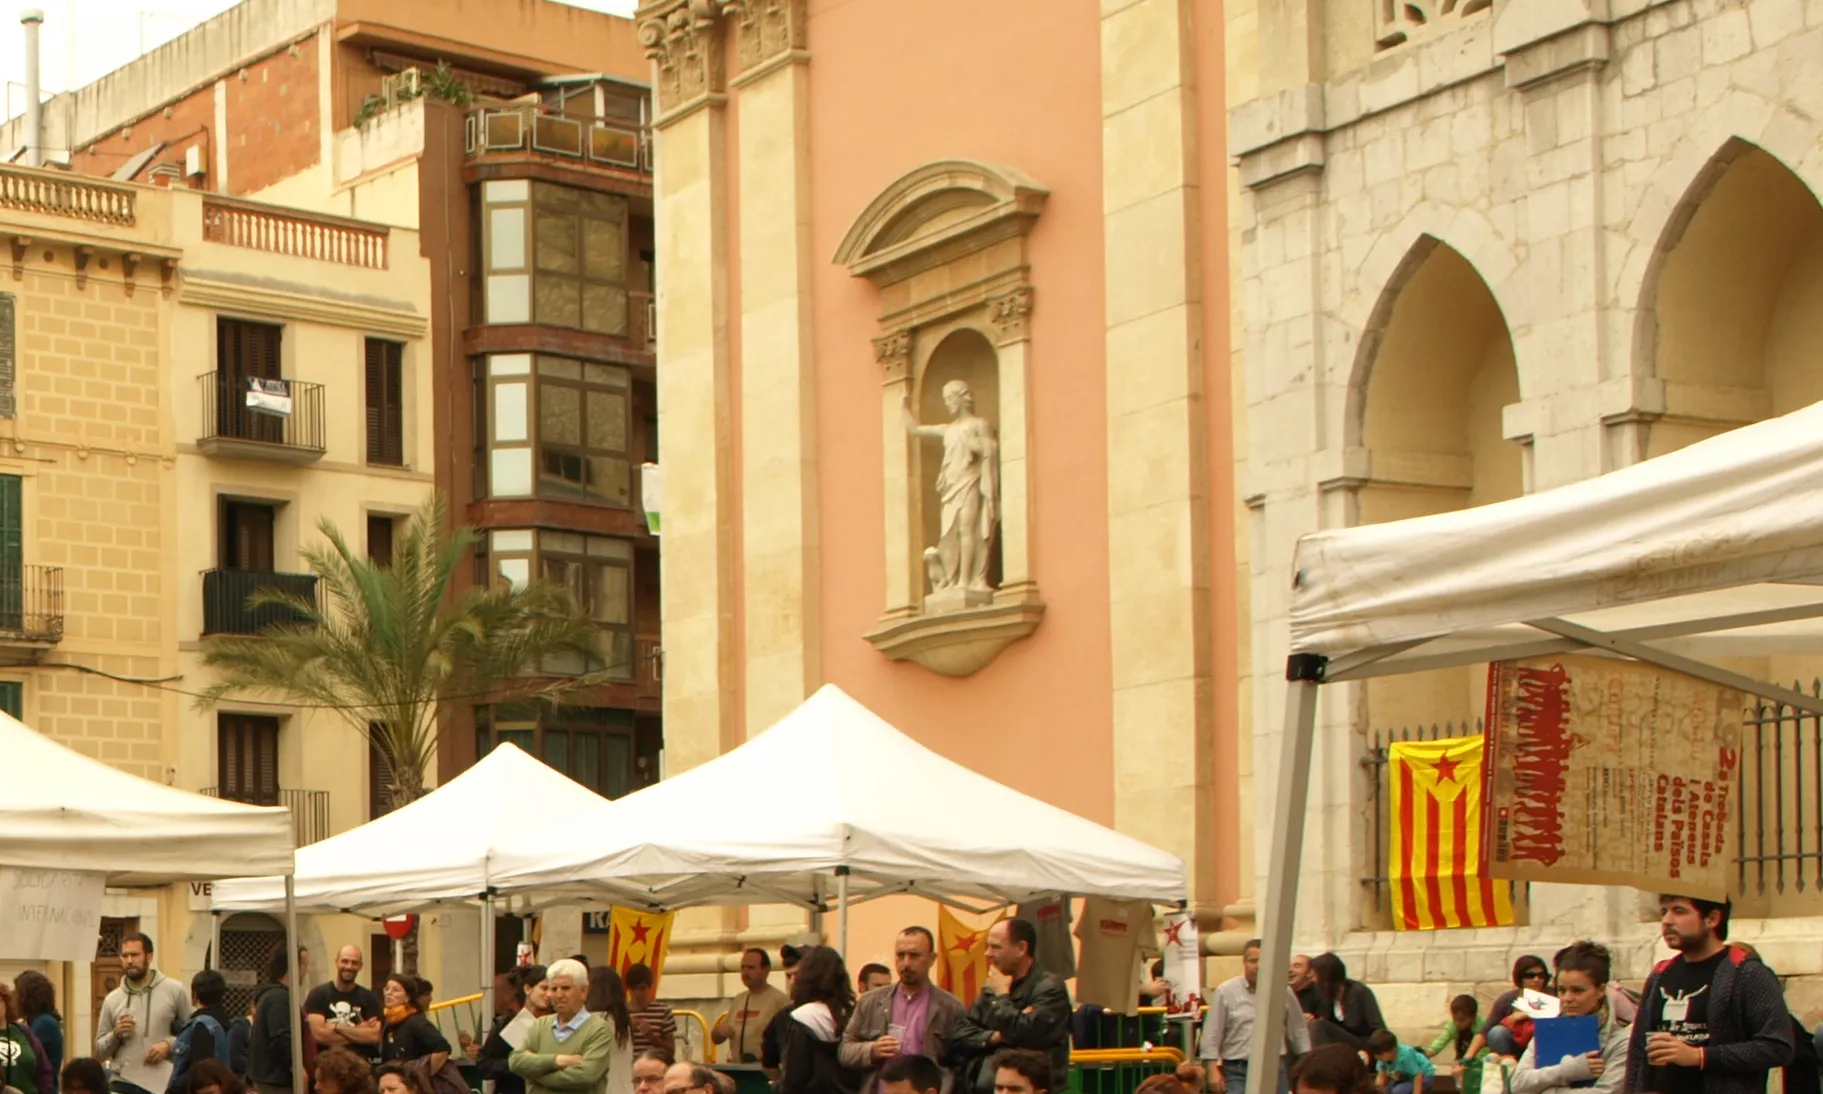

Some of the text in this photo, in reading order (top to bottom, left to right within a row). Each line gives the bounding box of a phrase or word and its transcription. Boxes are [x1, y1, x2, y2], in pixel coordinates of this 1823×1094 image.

[1653, 773, 1670, 853] Catalans
[1669, 776, 1687, 879] dels Països
[1686, 791, 1701, 866] Ateneus
[1699, 780, 1716, 868] de Casals
[1714, 786, 1730, 855] Trobada
[191, 882, 212, 897] VE
